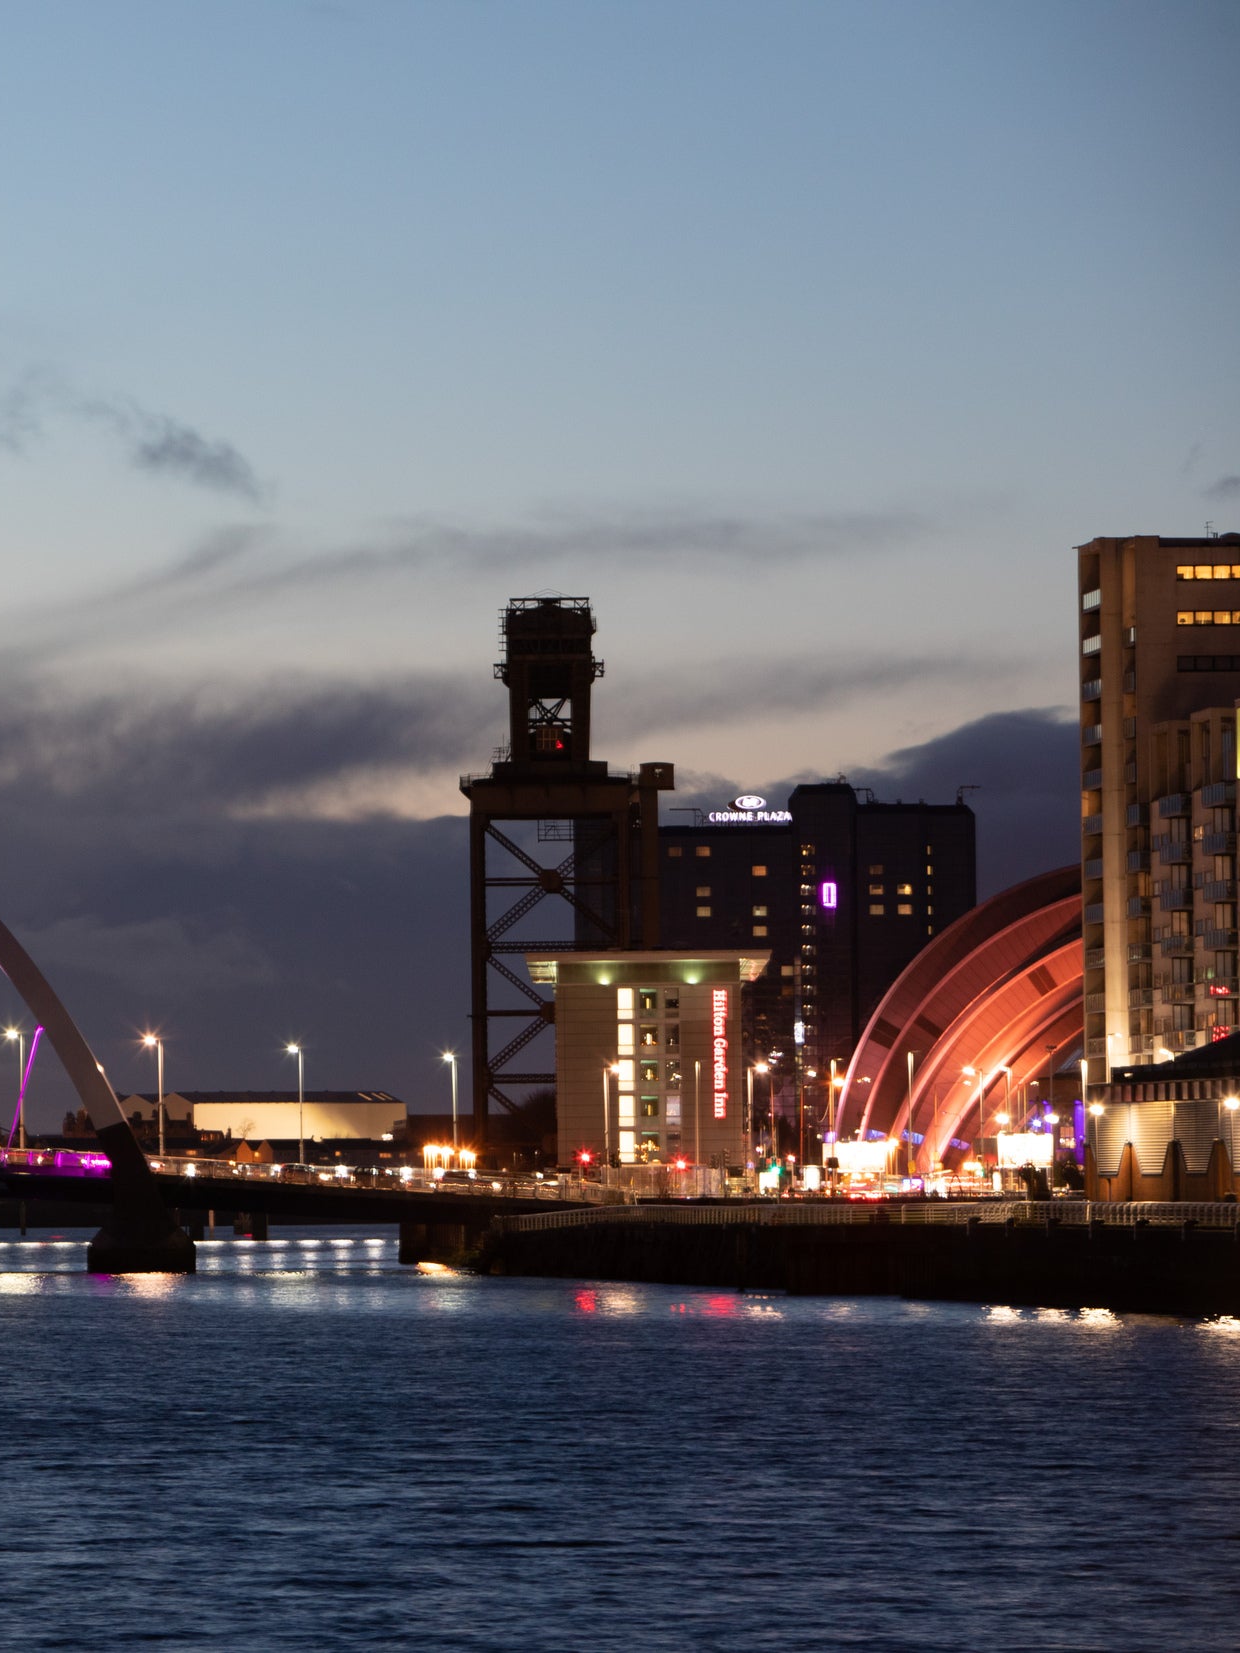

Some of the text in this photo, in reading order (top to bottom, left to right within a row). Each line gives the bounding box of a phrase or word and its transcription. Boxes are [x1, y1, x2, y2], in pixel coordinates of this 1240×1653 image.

[709, 811, 793, 822] CROWNE PLAZA
[712, 989, 728, 1119] Hilton Garden Inn
